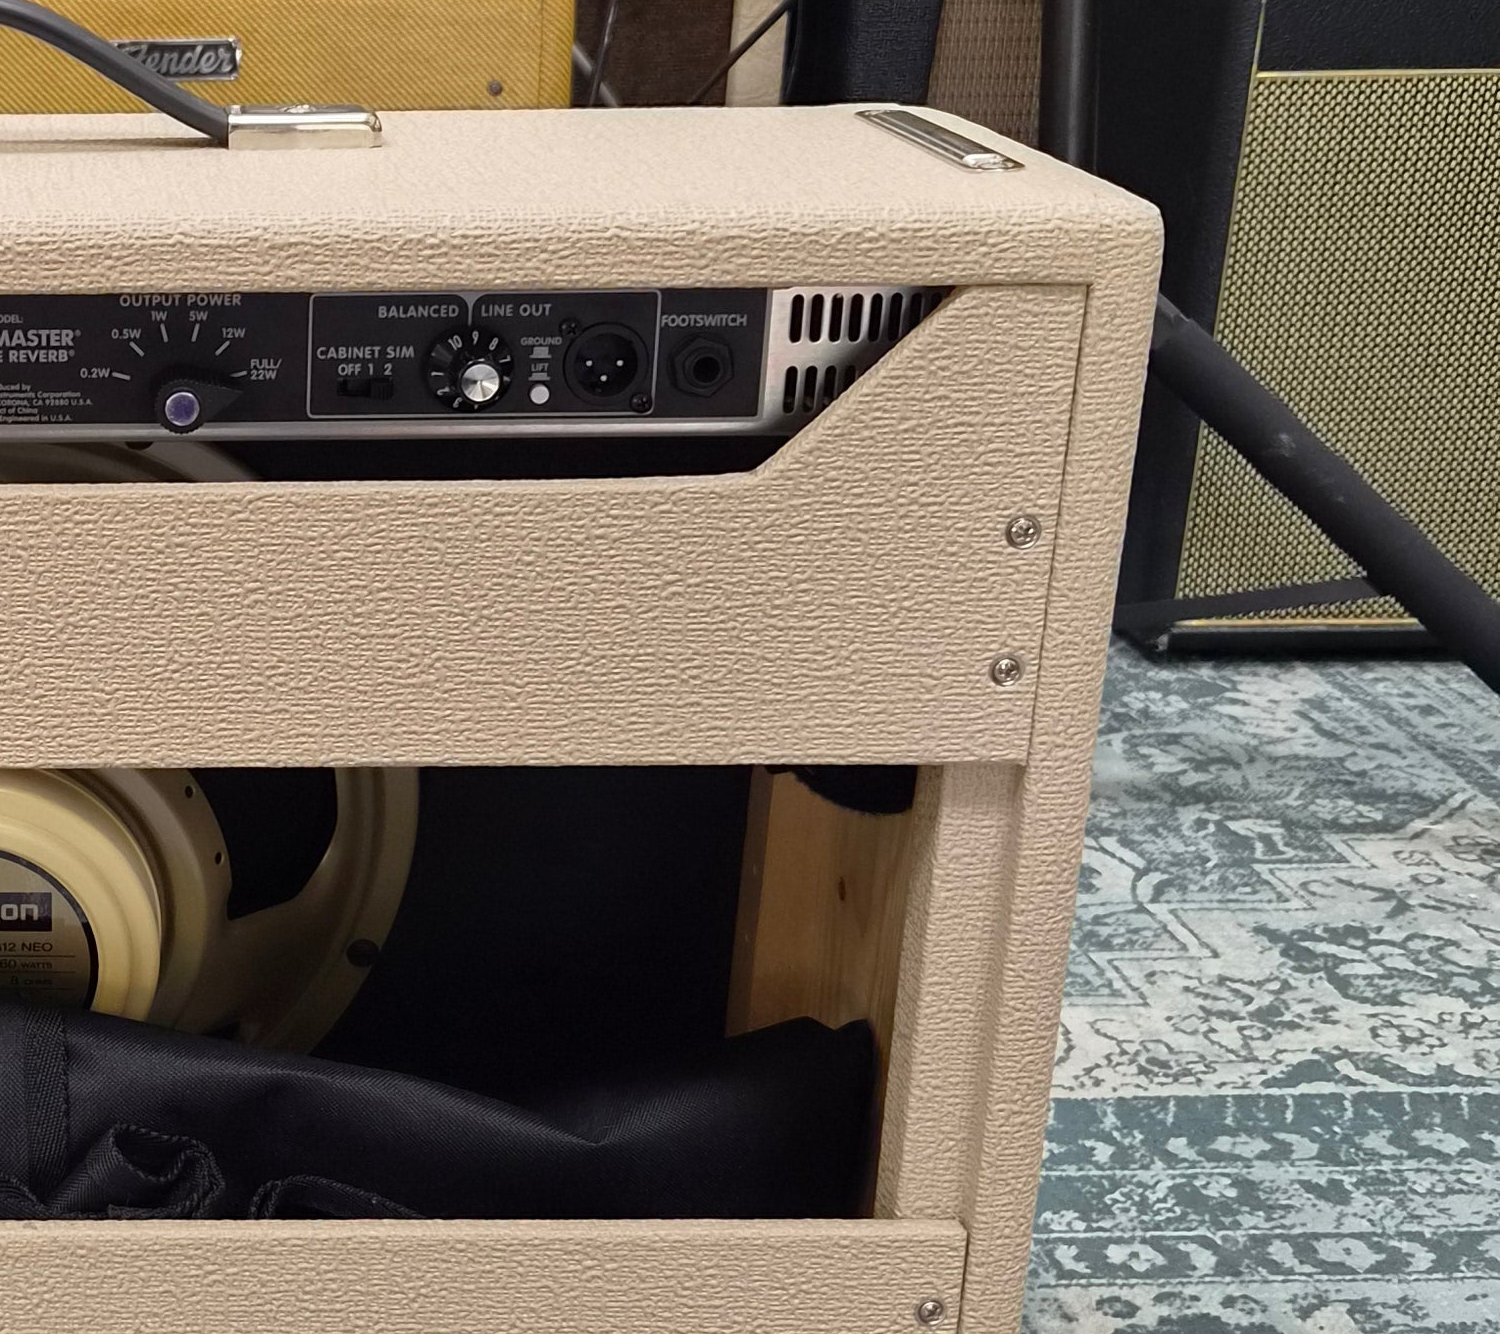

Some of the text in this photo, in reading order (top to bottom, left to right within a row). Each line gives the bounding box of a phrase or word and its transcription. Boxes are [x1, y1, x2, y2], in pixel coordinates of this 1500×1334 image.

[119, 294, 242, 307] OUTPUT POWER
[150, 310, 168, 322] 1W
[189, 310, 208, 322] 5W
[377, 303, 552, 318] BALANCED LINE OUT
[661, 314, 748, 328] FOOTSWITCH
[111, 328, 142, 340] 0.5W
[222, 327, 246, 339] 12W
[471, 331, 479, 345] 9
[448, 334, 463, 350] 10
[488, 337, 499, 351] 8
[520, 336, 562, 346] GROUND
[316, 346, 415, 360] CABINET SIM
[250, 358, 282, 370] FULL/
[337, 363, 393, 376] OFF 1 2
[531, 362, 550, 372] LIFT
[80, 368, 111, 379] 0.2W
[250, 370, 278, 381] 22W
[21, 384, 31, 393] by
[37, 391, 81, 400] Corporation
[17, 406, 39, 415] China
[21, 941, 53, 953] NEO
